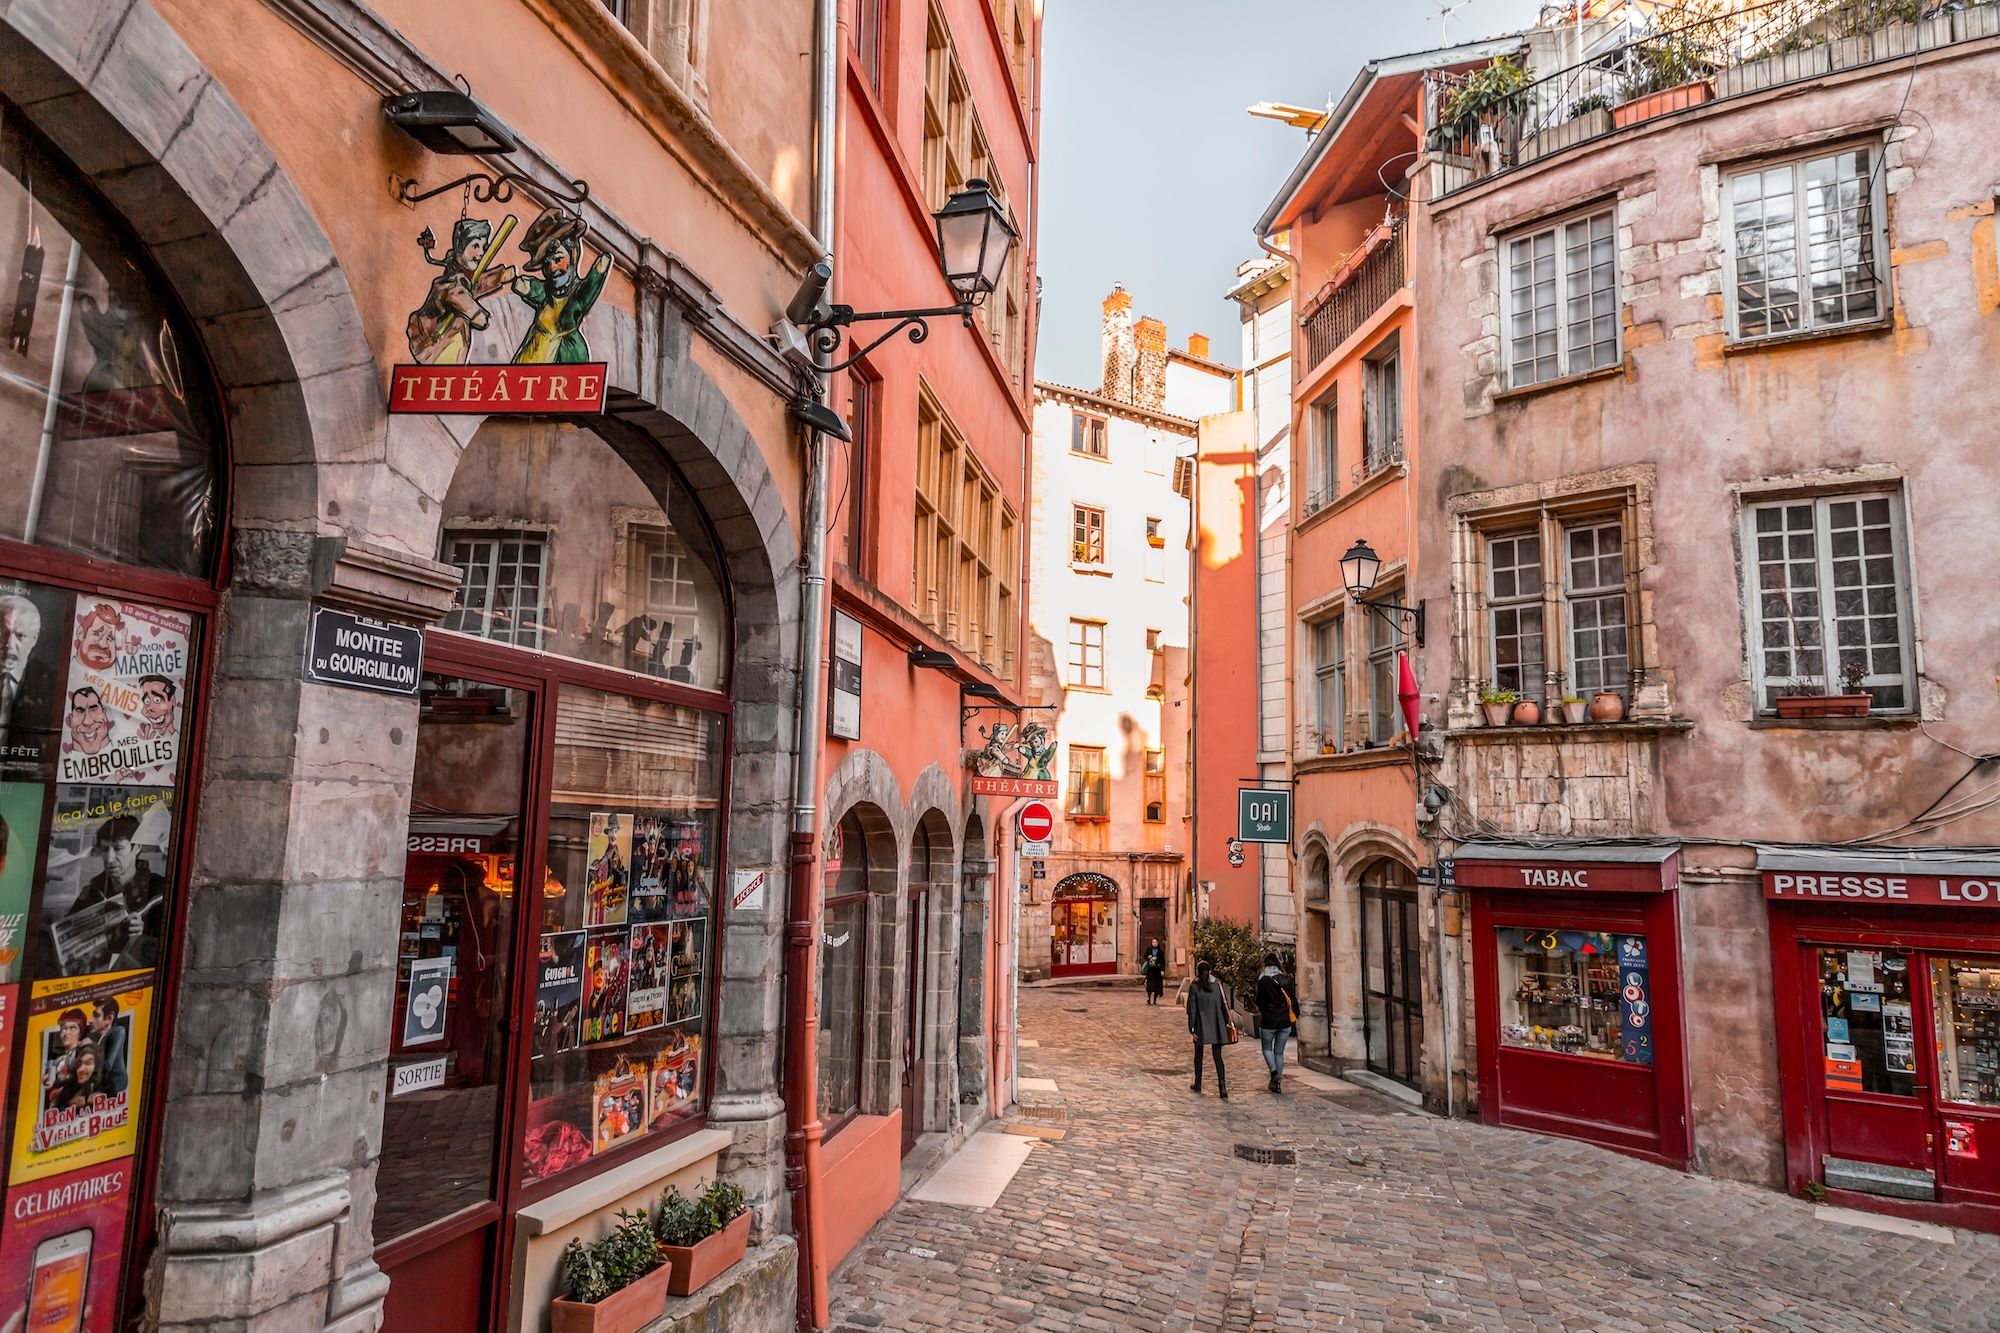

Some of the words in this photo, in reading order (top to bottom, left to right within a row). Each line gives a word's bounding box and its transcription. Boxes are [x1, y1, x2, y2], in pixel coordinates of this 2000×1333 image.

[400, 370, 599, 401] THÉÂTRE
[124, 605, 133, 614] 10
[134, 609, 148, 619] ans
[149, 613, 159, 622] de
[143, 642, 165, 652] MON
[336, 628, 402, 658] MONTEE
[316, 658, 327, 669] DU
[330, 653, 414, 684] GOURGUILLON
[83, 673, 104, 688] MES
[117, 735, 138, 748] MES
[11, 745, 40, 757] FÊTE
[974, 780, 1056, 795] THÉÂTRE
[87, 805, 105, 817] va
[109, 801, 122, 812] le
[127, 794, 157, 809] faire
[1250, 800, 1278, 822] OAÏ
[1521, 869, 1588, 887] TABAC
[1774, 875, 1908, 899] PRESSE
[736, 876, 762, 904] LICENCE
[1626, 1040, 1637, 1055] 5
[1640, 1036, 1648, 1047] 2
[398, 1064, 442, 1087] SORTIE
